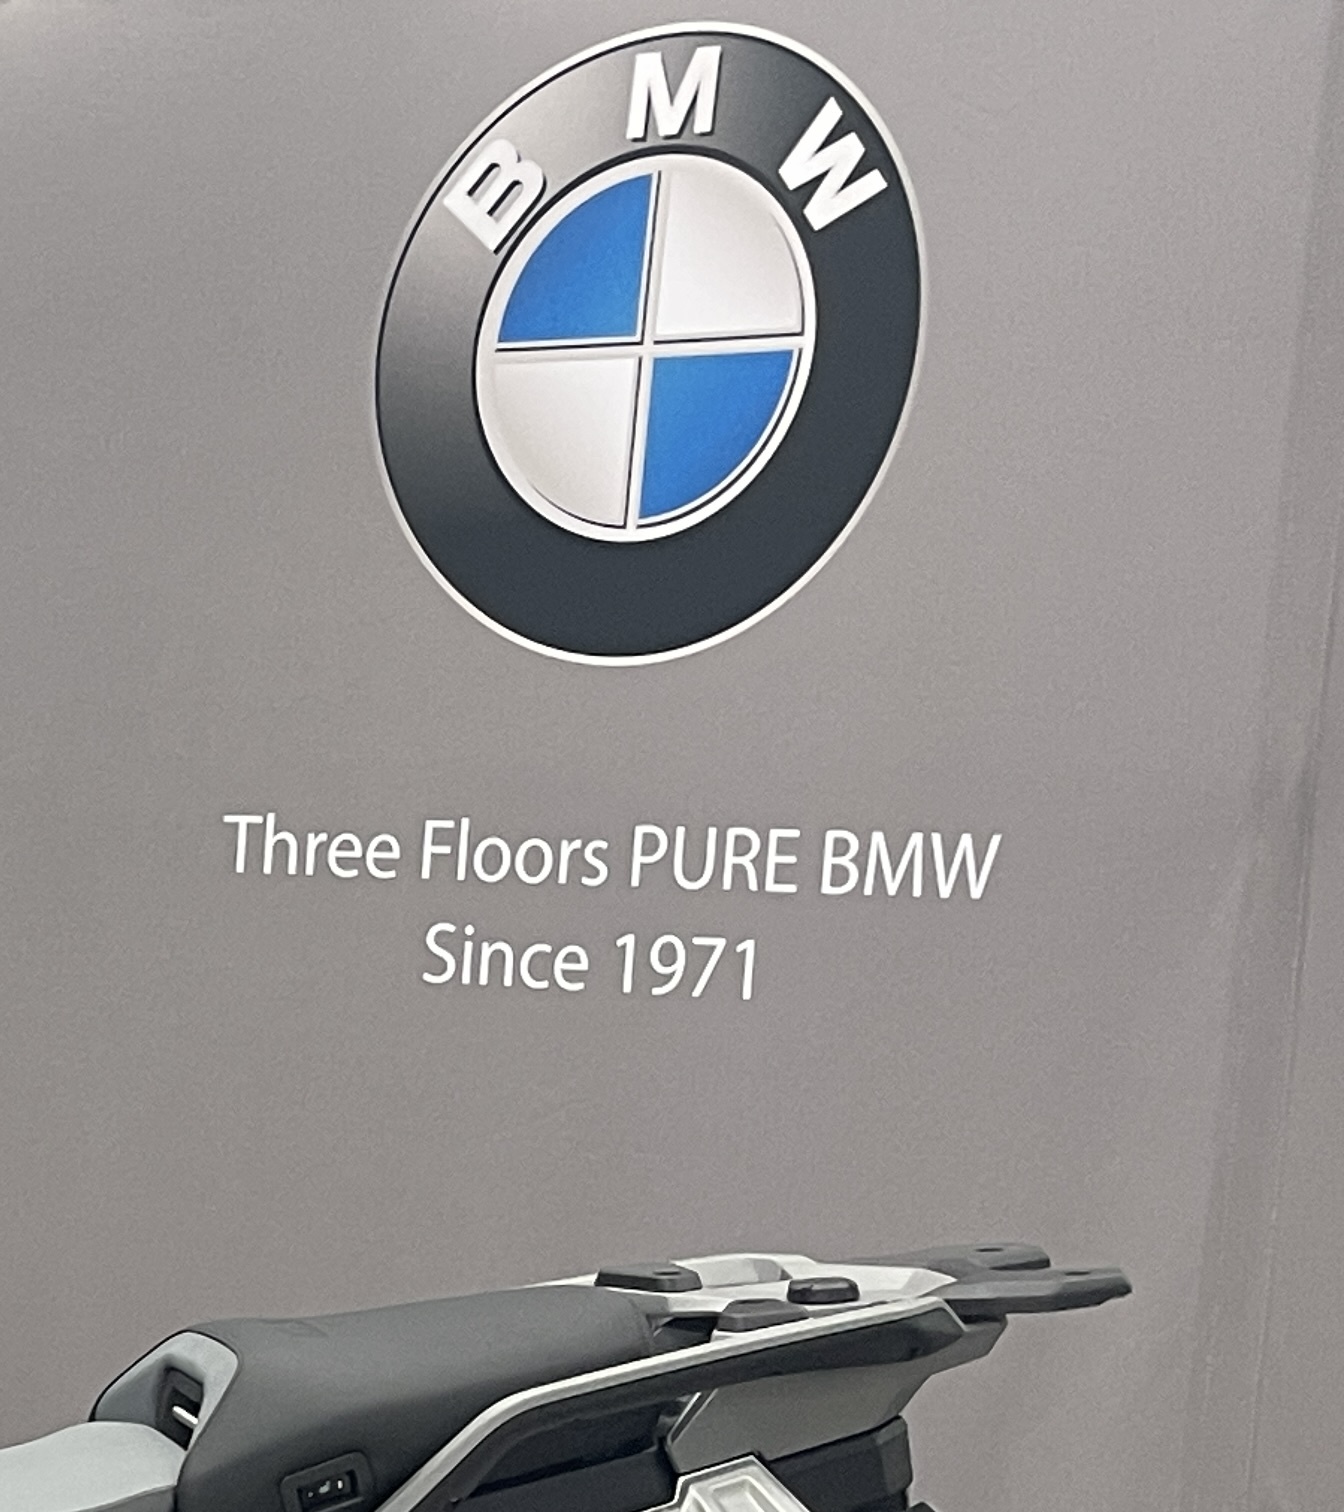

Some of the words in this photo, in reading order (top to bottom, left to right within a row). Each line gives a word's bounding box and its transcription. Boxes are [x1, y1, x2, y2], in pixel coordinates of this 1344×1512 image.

[442, 45, 888, 252] BMW
[221, 812, 401, 880] Three
[421, 817, 609, 888] Floors
[630, 824, 802, 894] PURE
[820, 829, 1003, 900] BMW
[421, 922, 590, 992] Since
[615, 932, 757, 1001] 1971
